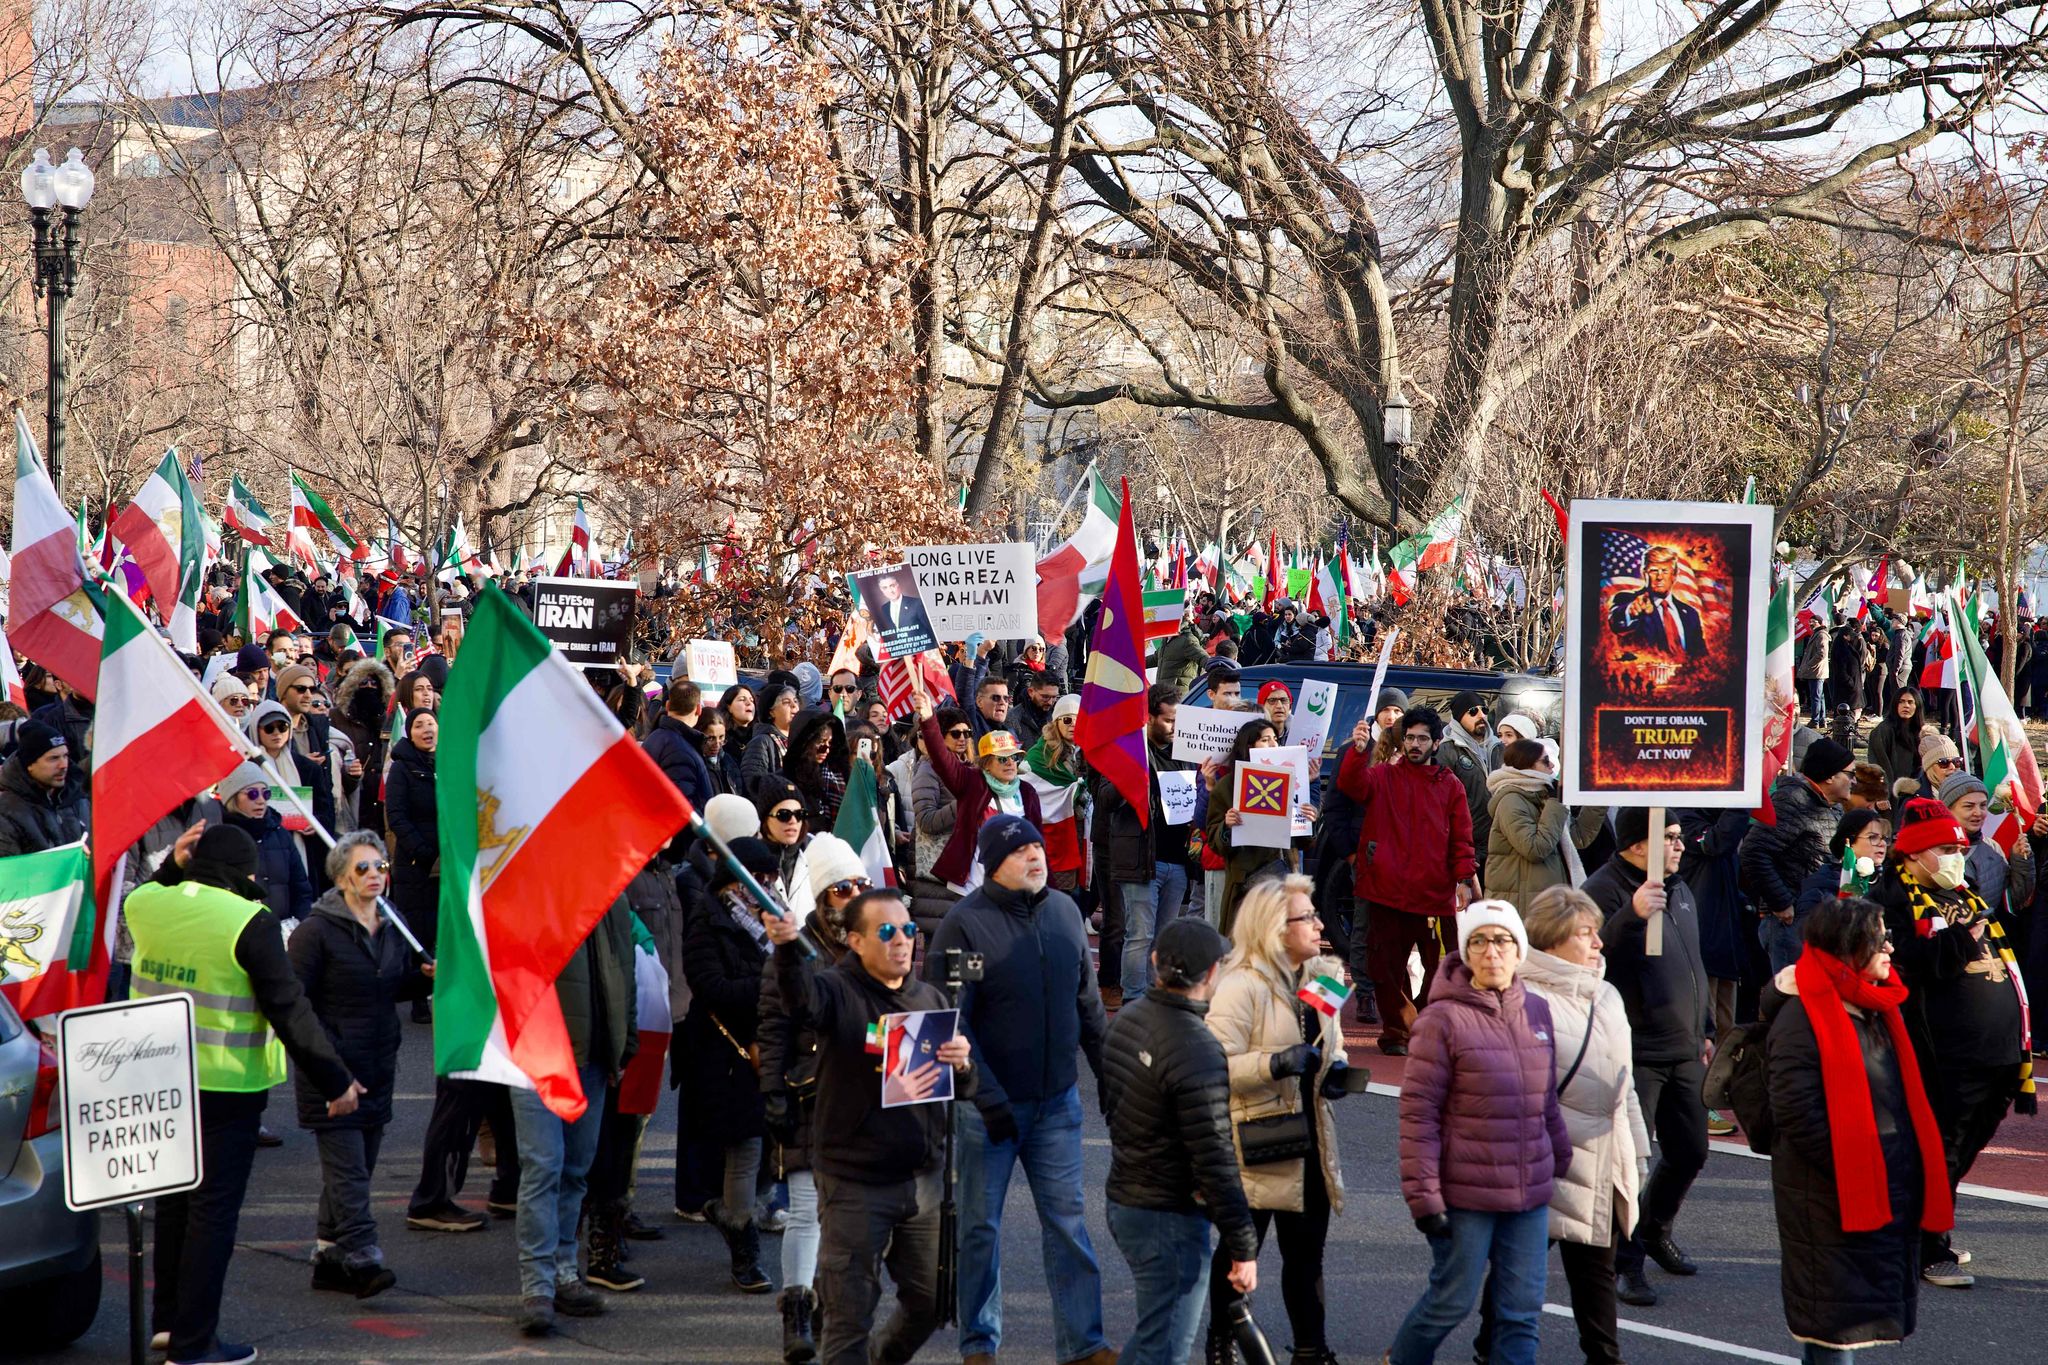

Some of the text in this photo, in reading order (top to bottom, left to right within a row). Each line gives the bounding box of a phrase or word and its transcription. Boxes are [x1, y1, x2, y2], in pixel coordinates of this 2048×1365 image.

[911, 550, 995, 567] LONG LIVE
[857, 565, 902, 579] LONG LIVE IRAN
[920, 569, 1015, 587] KING REZA
[540, 593, 594, 607] ALL EYES ON
[935, 589, 1009, 606] PAHLAVI
[538, 604, 594, 630] IRAN
[977, 613, 1021, 631] IRAN
[881, 624, 919, 636] REZA PAHLAVI
[897, 631, 908, 639] FOR
[914, 633, 928, 641] IRAN
[570, 642, 591, 652] CHANGE
[599, 641, 616, 653] IRAN
[891, 646, 926, 657] MIDDLE EAST
[706, 654, 729, 668] IRAN
[1307, 686, 1330, 717] زن
[1624, 716, 1654, 725] DON'T
[1655, 716, 1668, 725] BE
[1177, 730, 1199, 740] Iran
[1198, 722, 1240, 735] Unblock
[1632, 728, 1698, 745] TRUMP
[1187, 741, 1197, 750] to
[1199, 742, 1216, 752] the
[1637, 749, 1692, 760] ACT NOW
[79, 1088, 182, 1125] RESERVED
[88, 1118, 176, 1153] PARKING
[107, 1150, 159, 1179] ONLY
